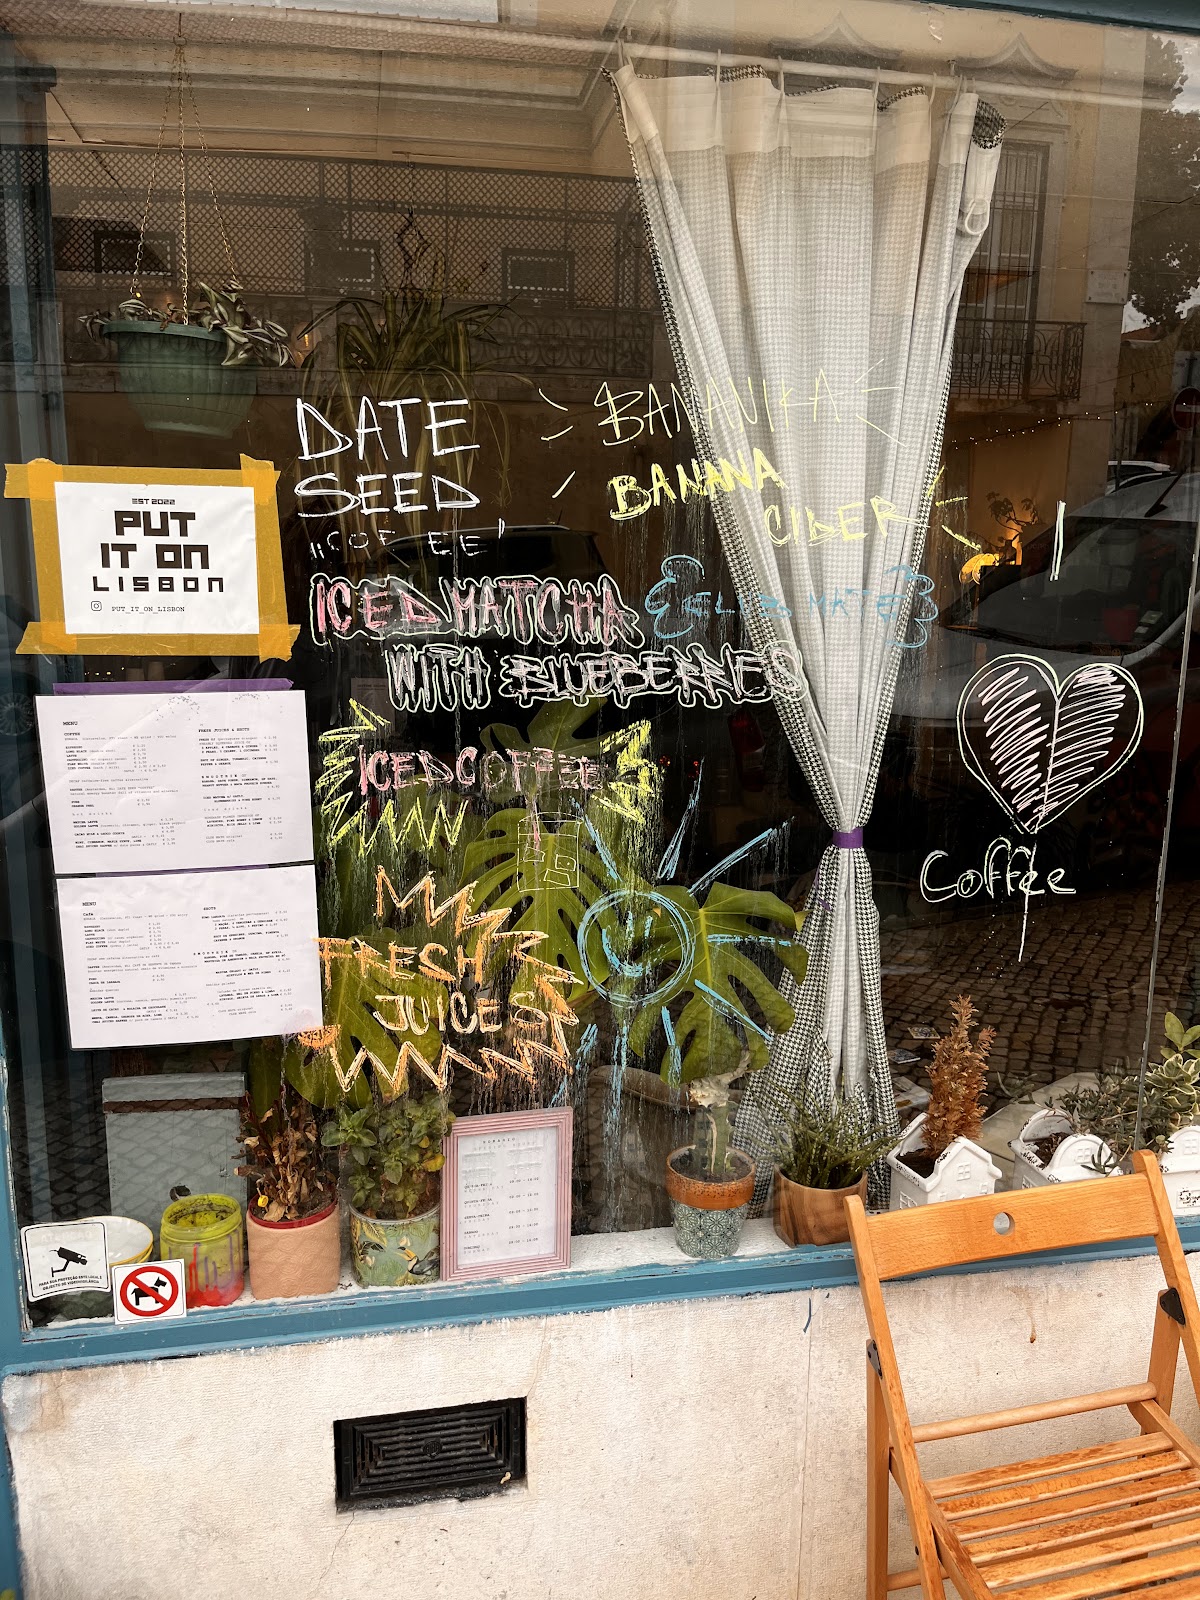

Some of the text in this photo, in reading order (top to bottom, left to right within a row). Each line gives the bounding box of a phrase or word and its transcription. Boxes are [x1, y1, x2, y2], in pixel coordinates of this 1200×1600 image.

[296, 395, 480, 461] DATE
[294, 471, 480, 518] SEED
[608, 447, 789, 521] BANANA
[114, 510, 196, 537] PUT
[763, 494, 930, 547] CIDER
[100, 543, 209, 569] IT ON
[93, 576, 224, 592] LISBON
[316, 576, 637, 645] ICED MATCHA
[391, 643, 802, 706] WITH BLUEBERRIES
[359, 745, 603, 795] ICED COFFEE
[920, 836, 1076, 903] Coffee
[313, 935, 483, 990] FRESH
[372, 990, 549, 1037] JUICES
